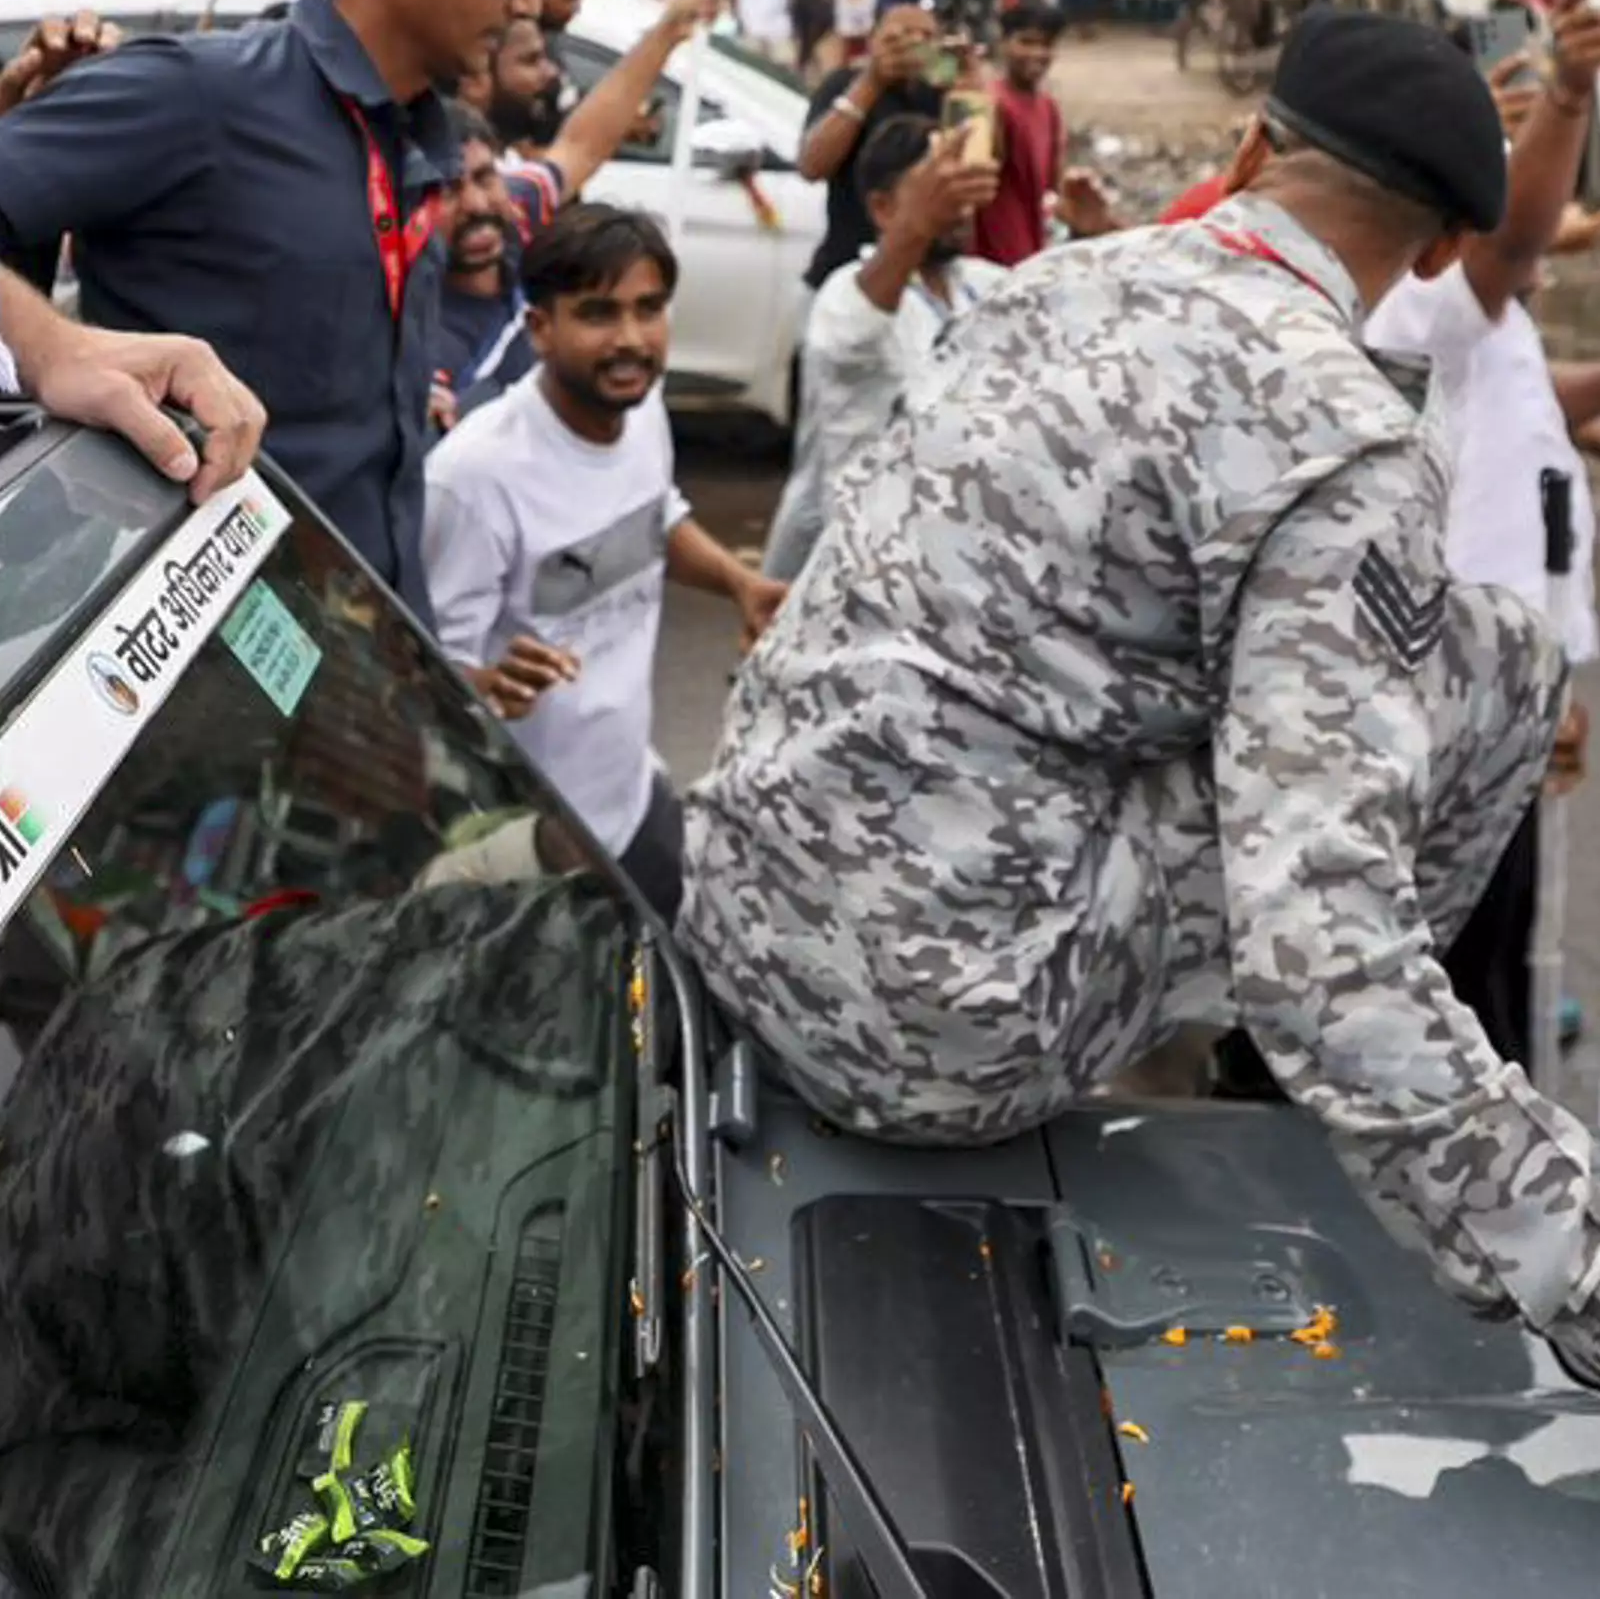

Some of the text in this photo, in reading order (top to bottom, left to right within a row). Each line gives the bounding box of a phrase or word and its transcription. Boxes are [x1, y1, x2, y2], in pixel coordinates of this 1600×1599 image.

[113, 503, 264, 683] वोटर अधिकार यात्रा
